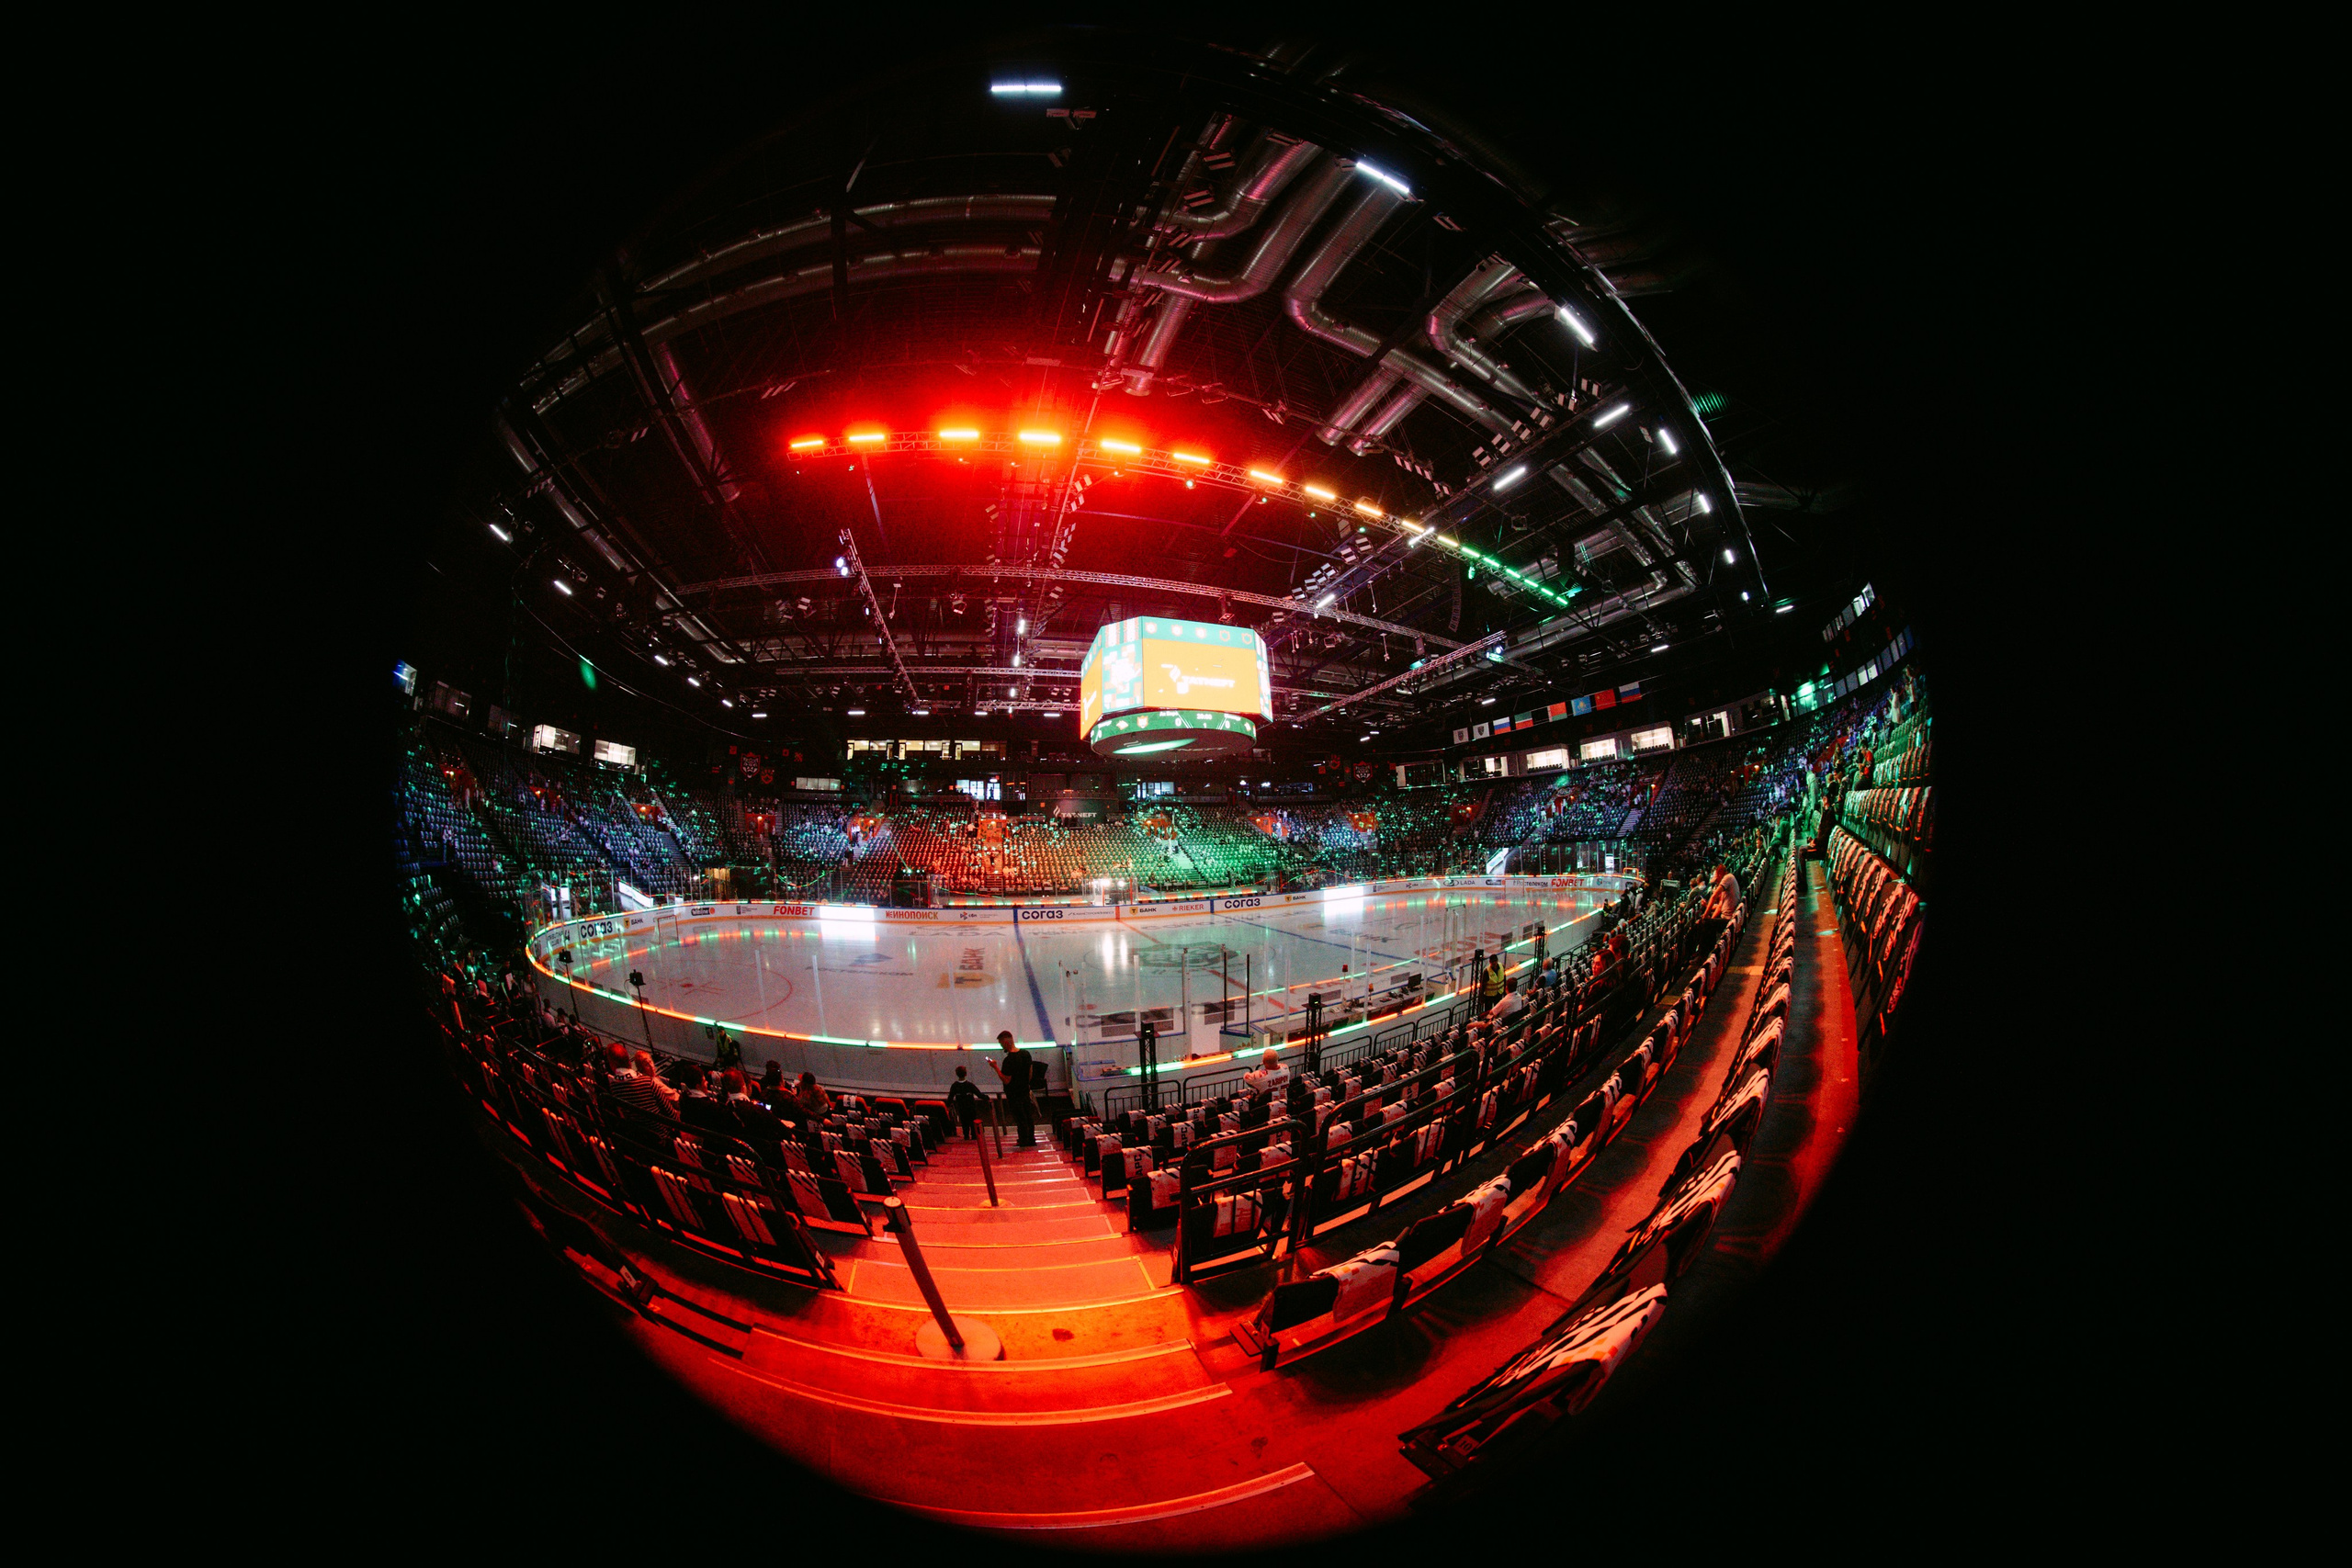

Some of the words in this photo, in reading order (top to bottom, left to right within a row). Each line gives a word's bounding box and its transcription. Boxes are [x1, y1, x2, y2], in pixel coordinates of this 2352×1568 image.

[1551, 878, 1584, 887] FONBET
[774, 906, 815, 916] FONBET
[1134, 1154, 1143, 1177] АРС
